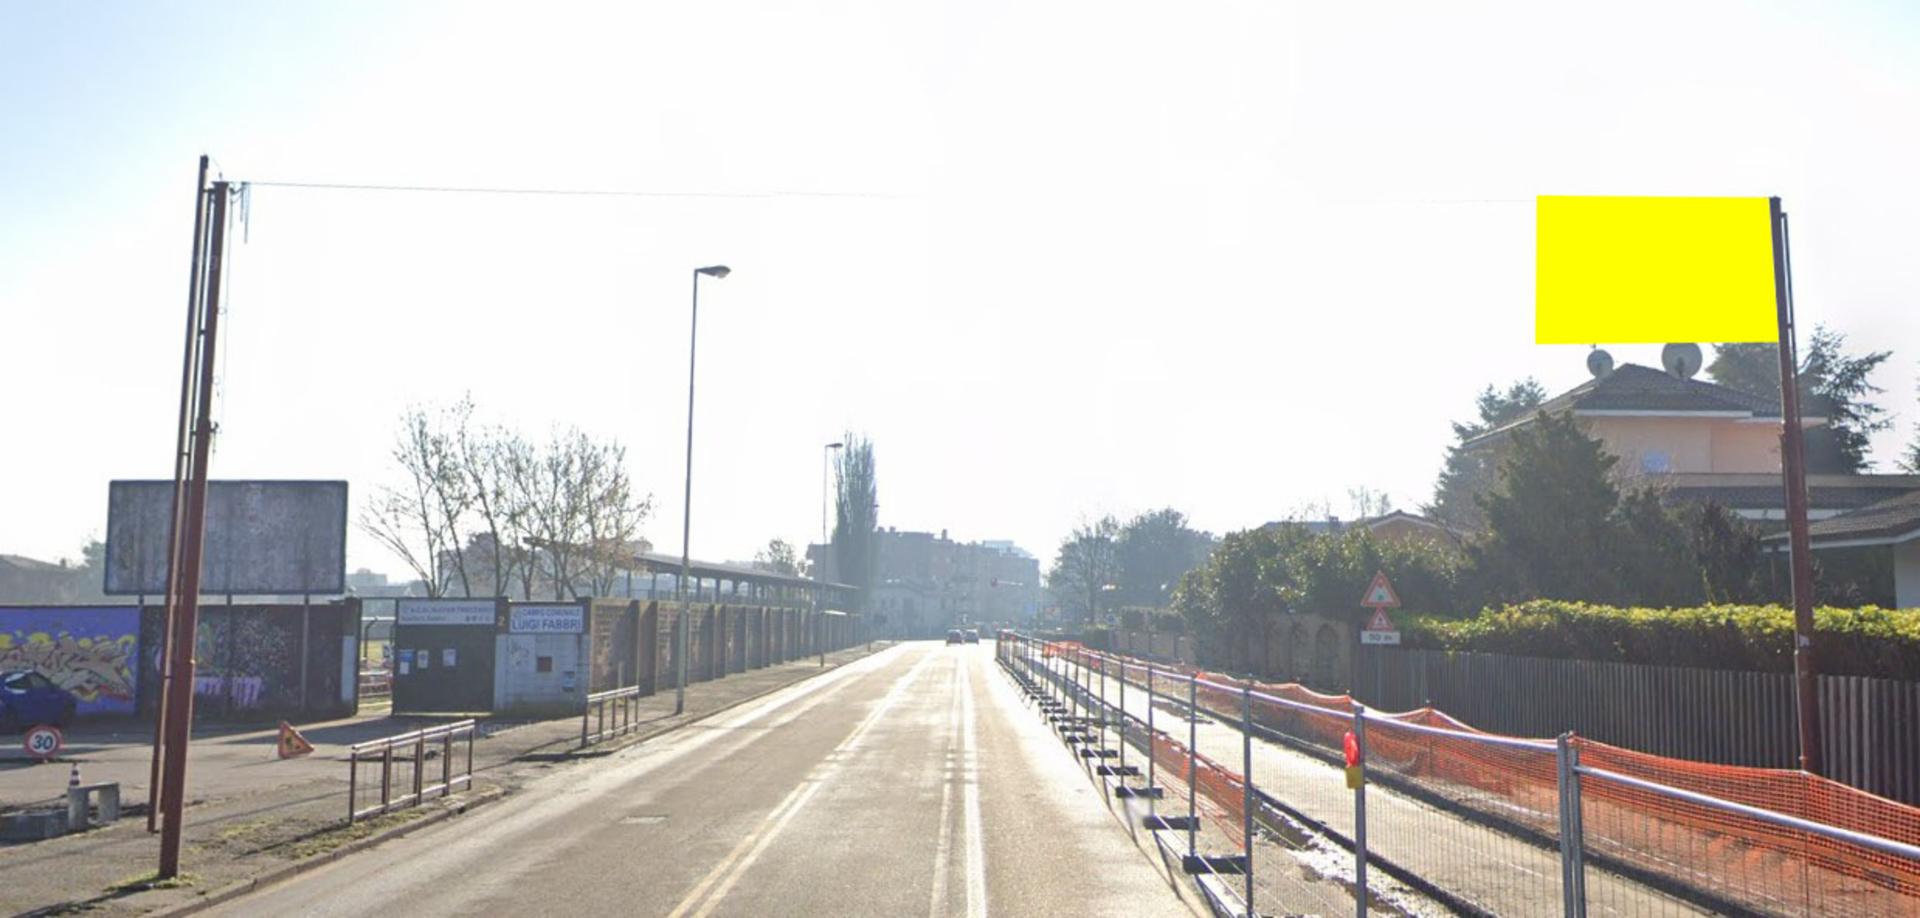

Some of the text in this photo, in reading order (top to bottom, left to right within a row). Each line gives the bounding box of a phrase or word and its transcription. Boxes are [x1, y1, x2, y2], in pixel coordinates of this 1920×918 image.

[512, 619, 581, 630] LUIGI FABBRI
[33, 735, 54, 750] 30
